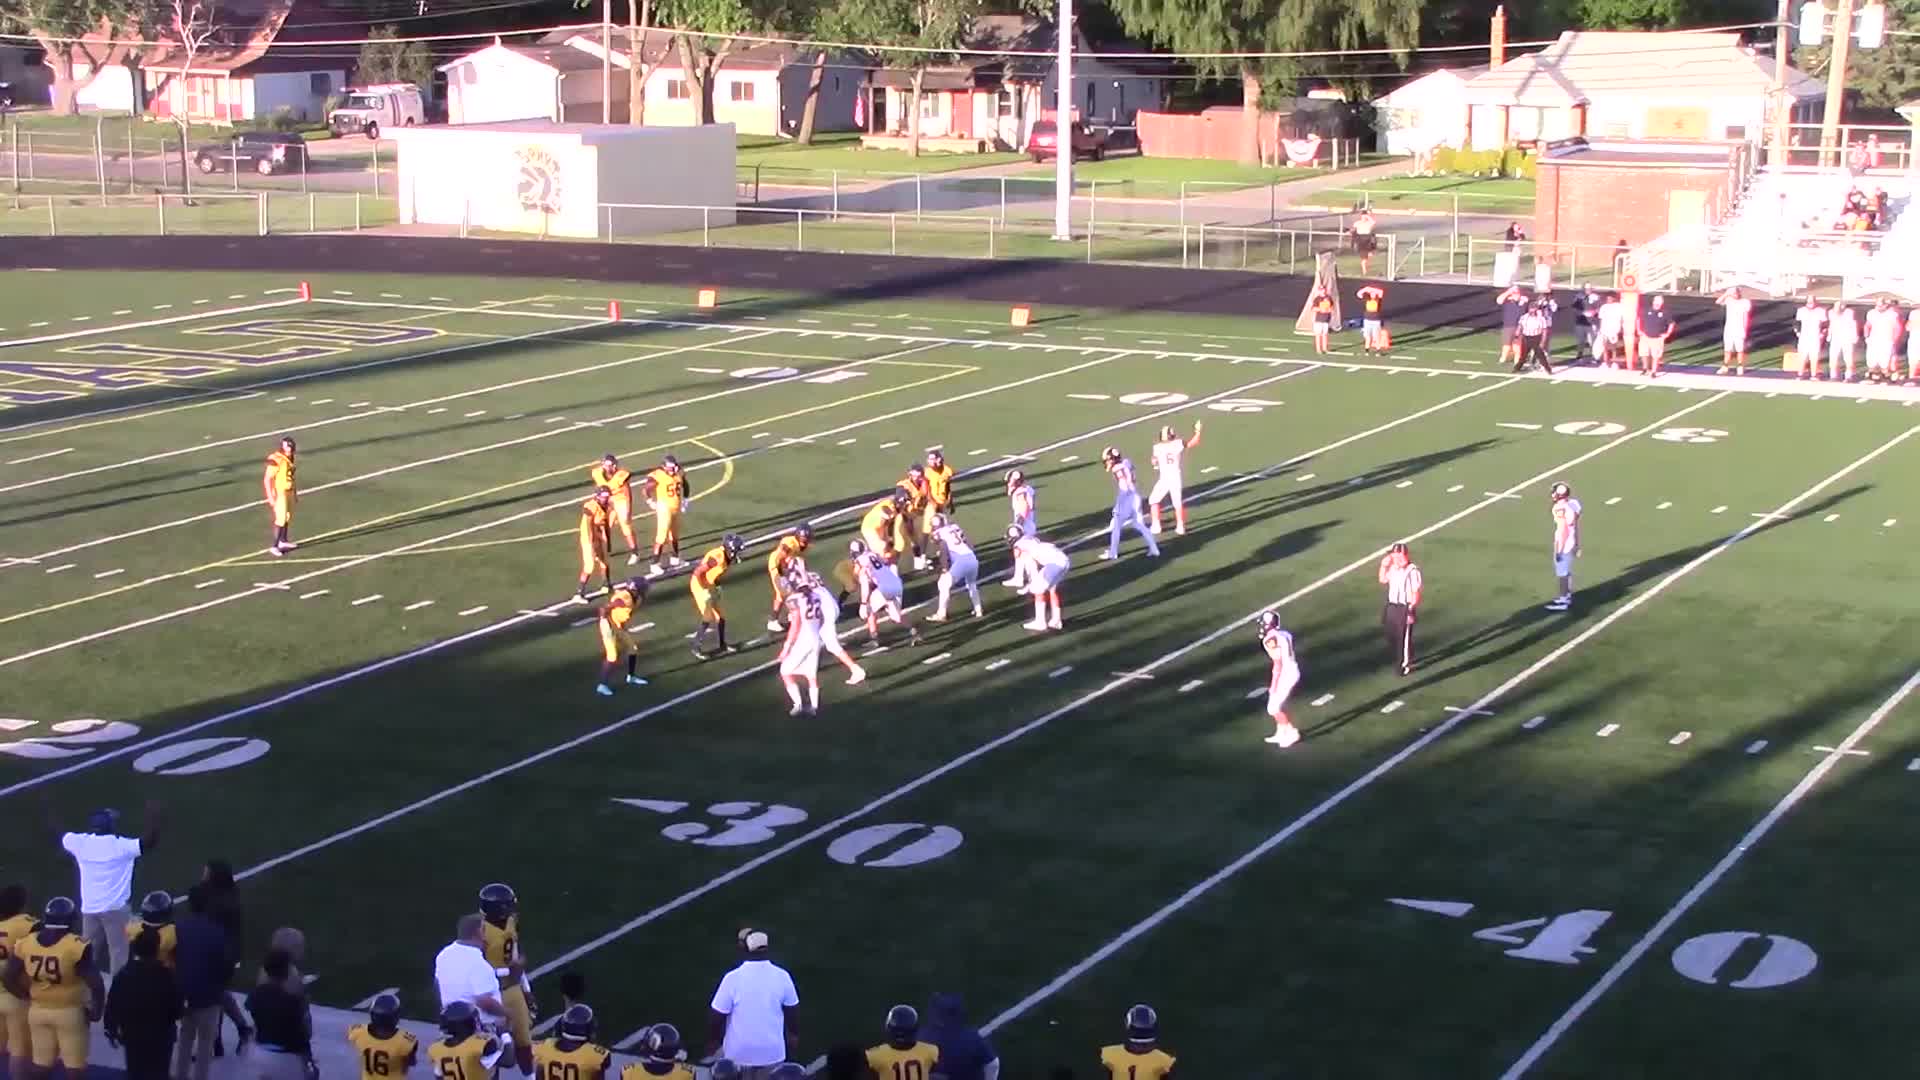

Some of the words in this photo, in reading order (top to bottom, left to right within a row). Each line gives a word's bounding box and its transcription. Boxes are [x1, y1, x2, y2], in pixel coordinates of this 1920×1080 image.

[0, 719, 272, 776] 20
[660, 800, 964, 868] 30
[1472, 909, 1818, 989] 40
[30, 954, 63, 985] 79
[363, 1047, 390, 1076] 16
[440, 1055, 467, 1080] 51
[548, 1060, 580, 1080] 60
[891, 1059, 923, 1080] 10
